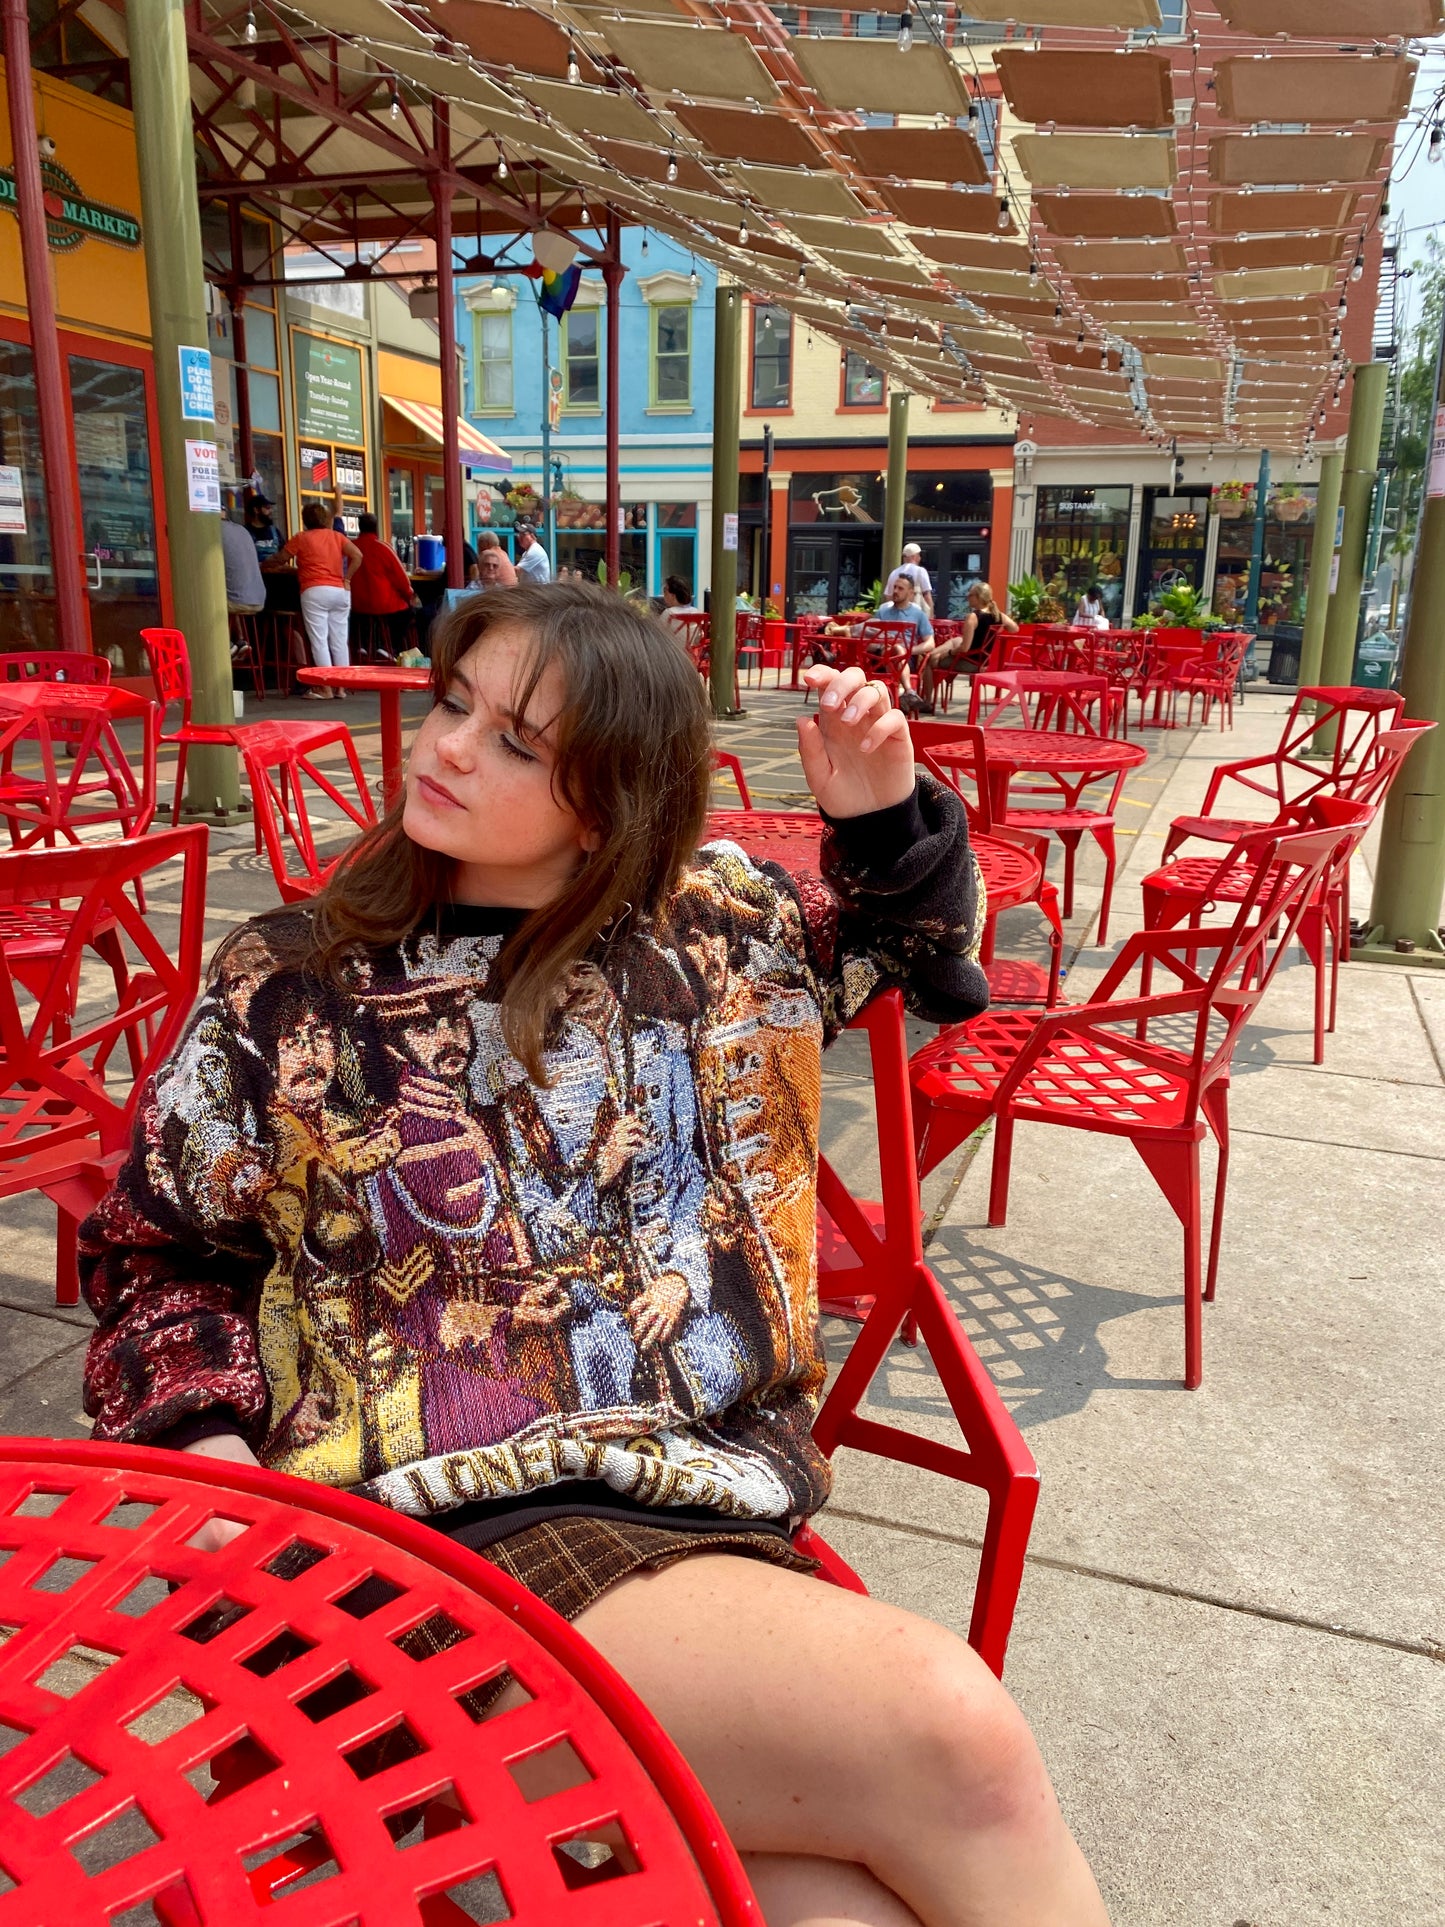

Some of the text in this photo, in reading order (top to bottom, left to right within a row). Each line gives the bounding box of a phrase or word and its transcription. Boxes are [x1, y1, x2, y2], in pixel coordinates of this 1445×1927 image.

[63, 199, 138, 241] MARKET
[188, 375, 203, 384] DO
[184, 392, 213, 402] TABLE
[192, 466, 210, 475] FOR
[1058, 502, 1107, 510] SUSTAINABLE
[404, 1438, 608, 1512] LONELY
